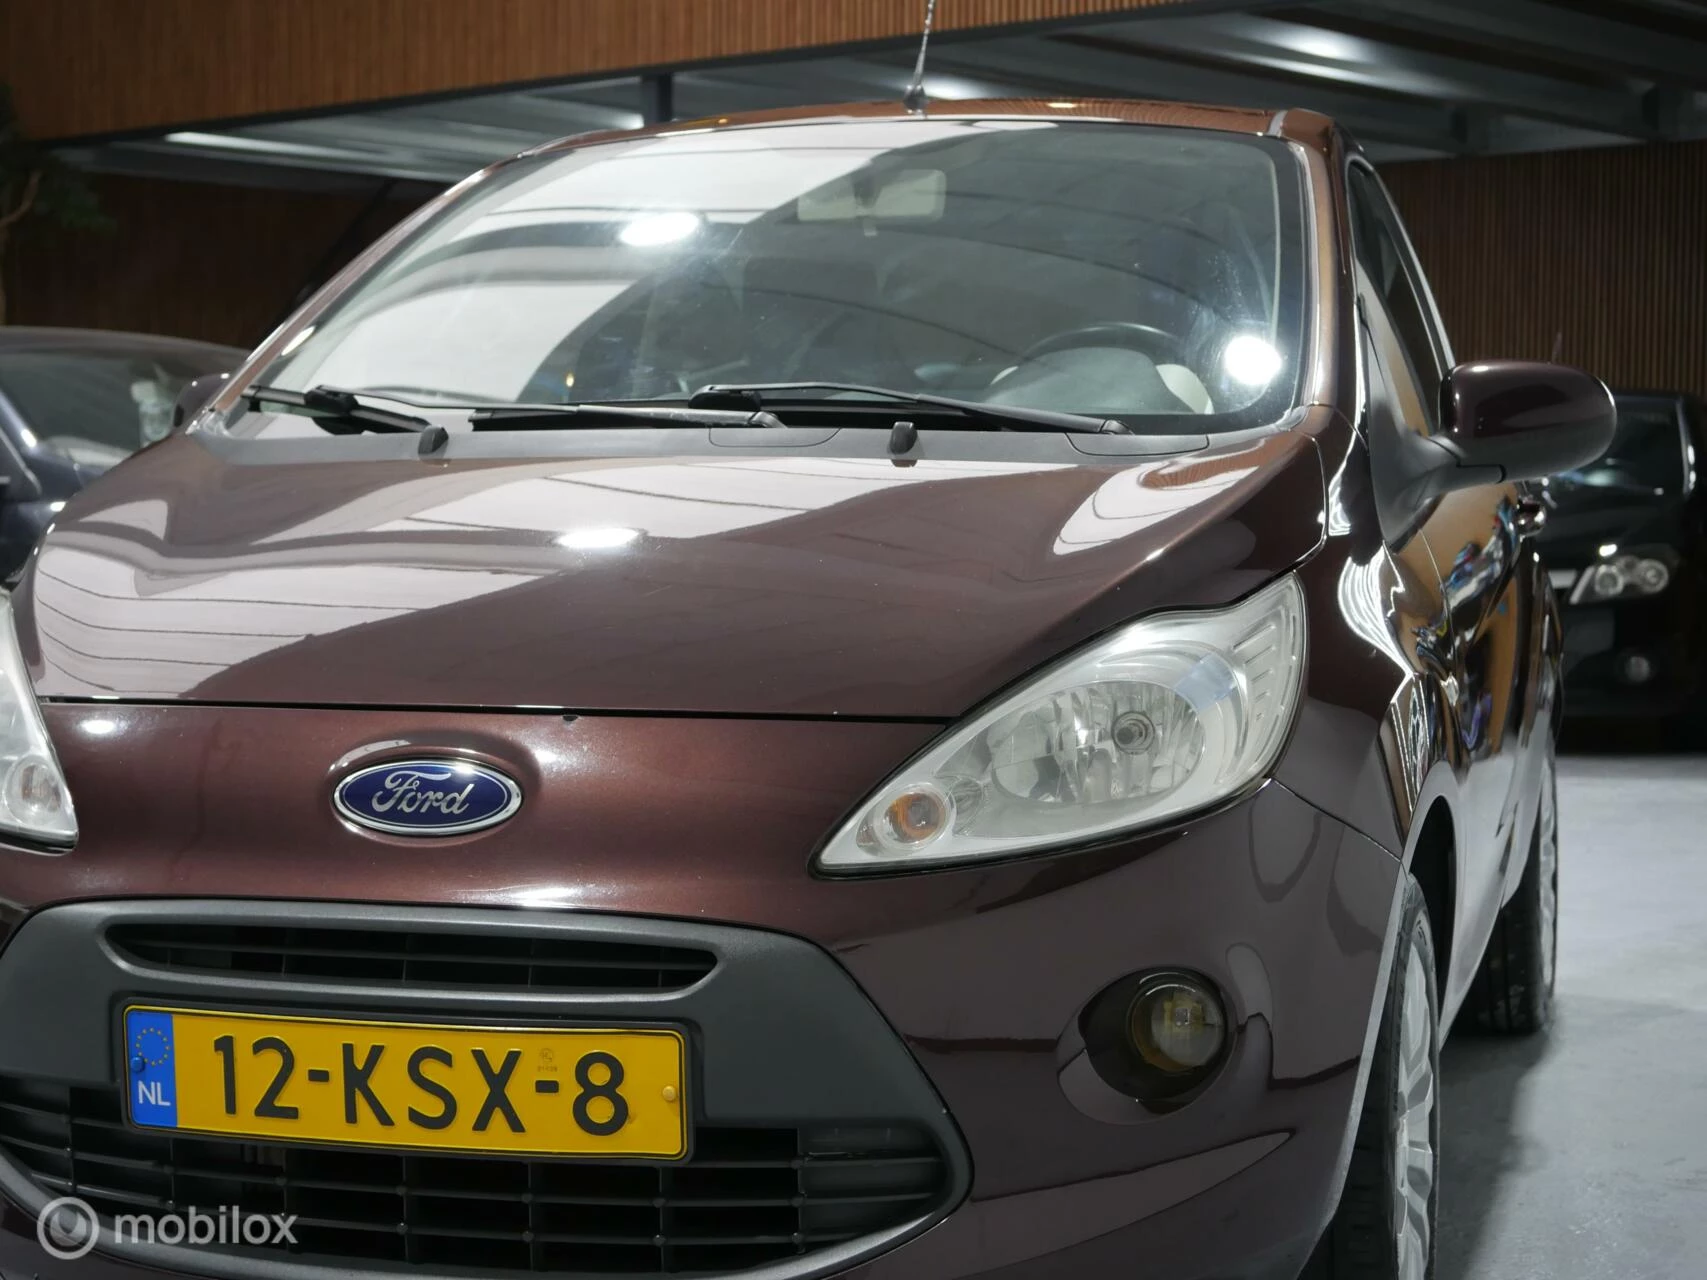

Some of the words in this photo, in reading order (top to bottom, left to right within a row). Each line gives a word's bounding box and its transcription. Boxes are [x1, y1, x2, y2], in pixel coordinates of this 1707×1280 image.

[371, 770, 475, 814] Ford
[137, 1081, 171, 1108] NL
[213, 1034, 630, 1136] 12-KSX-8
